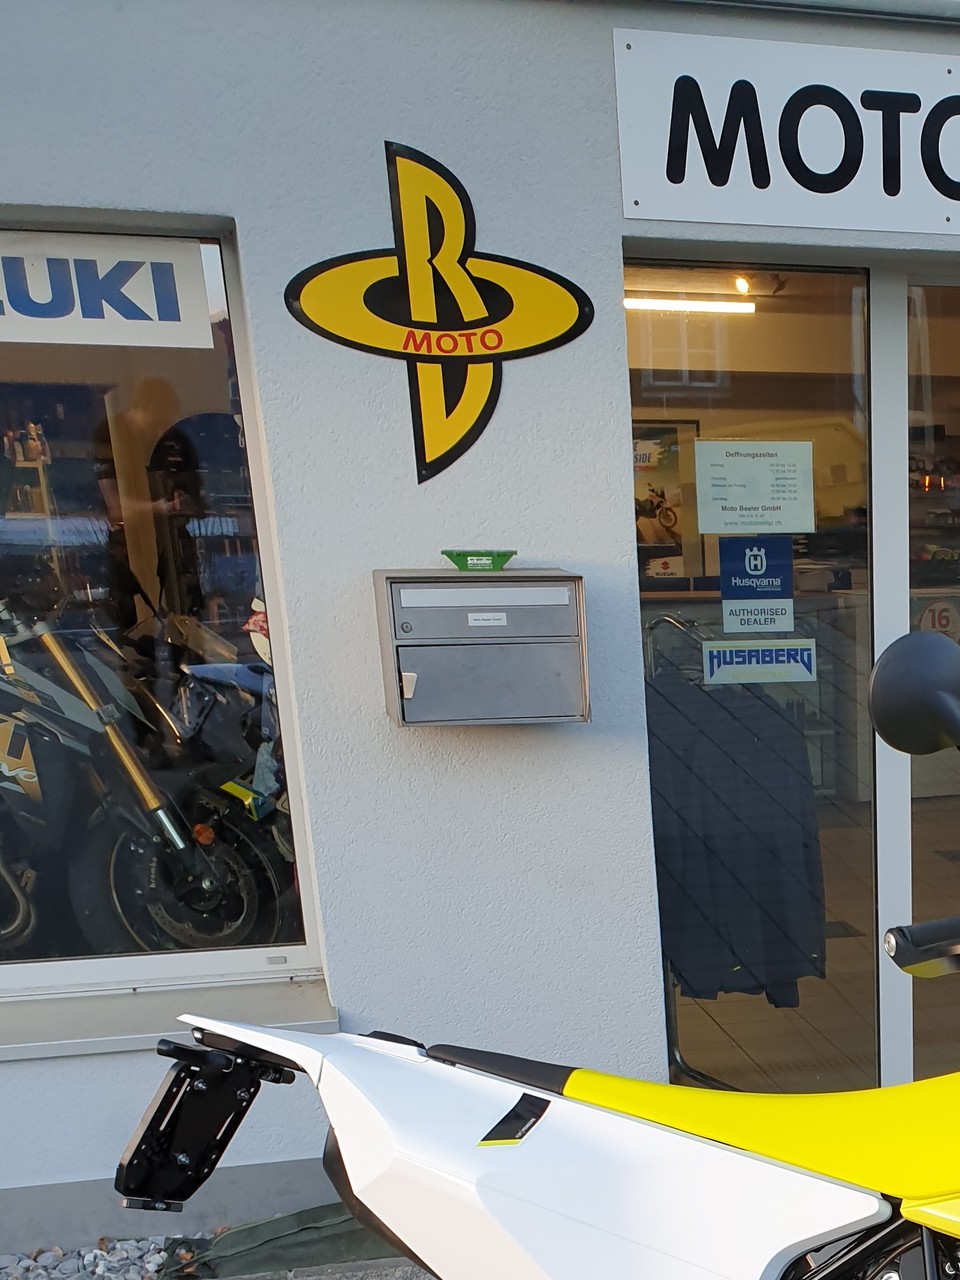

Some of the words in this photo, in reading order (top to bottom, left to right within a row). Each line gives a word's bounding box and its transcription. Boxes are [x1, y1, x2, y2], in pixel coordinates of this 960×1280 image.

[0, 256, 182, 322] UKI
[402, 329, 503, 354] MOTO
[731, 577, 781, 588] Husqvarna
[728, 608, 787, 617] AUTHORISED
[740, 618, 776, 626] DEALER
[928, 607, 951, 629] 16
[708, 648, 812, 679] HUSABERG
